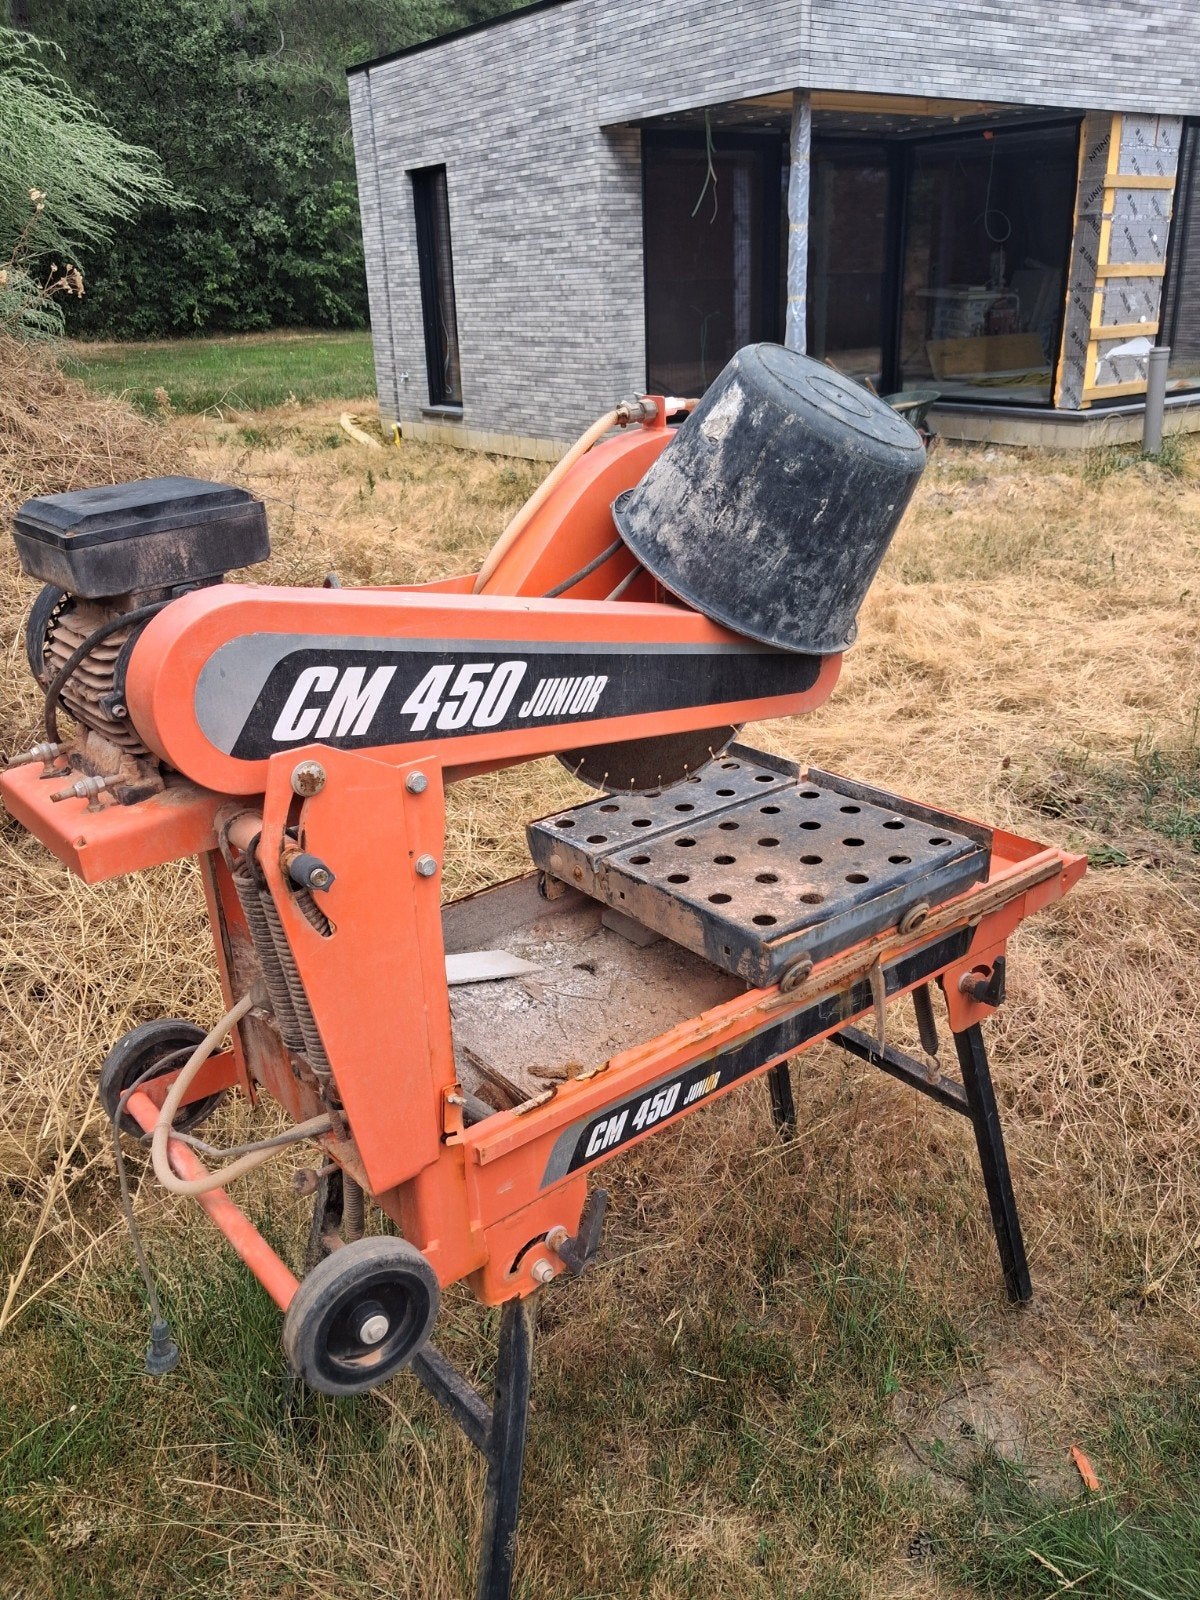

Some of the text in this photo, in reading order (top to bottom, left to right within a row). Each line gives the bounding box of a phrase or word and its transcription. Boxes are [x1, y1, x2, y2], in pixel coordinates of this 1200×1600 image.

[1088, 134, 1111, 162] UNILIN
[1083, 252, 1097, 273] UNIL
[1079, 302, 1091, 321] UNIL
[272, 661, 608, 742] CM 450 JUNIOR
[585, 1070, 721, 1158] CM 450 JUNIOR
